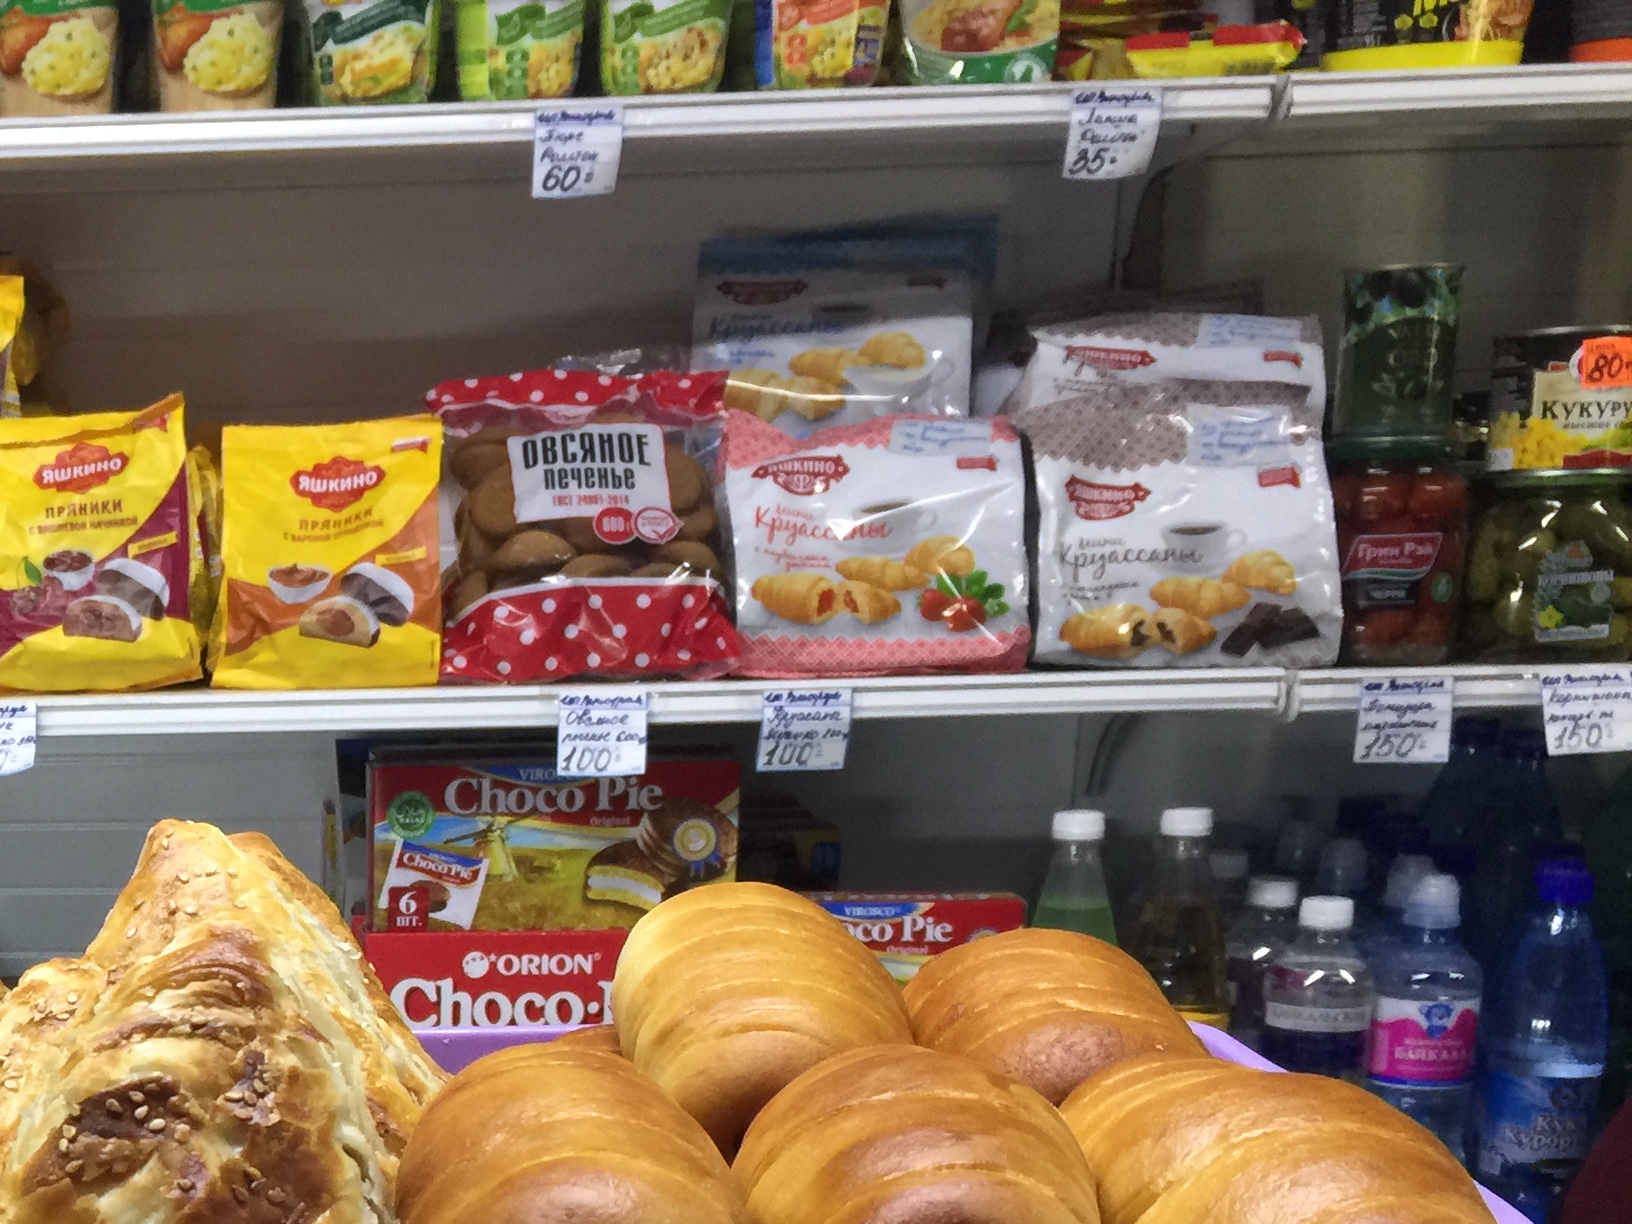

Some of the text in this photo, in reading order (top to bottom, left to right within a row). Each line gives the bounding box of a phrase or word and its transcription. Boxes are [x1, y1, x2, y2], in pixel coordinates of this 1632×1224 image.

[522, 432, 652, 470] ОВСЯНОЕ
[42, 456, 123, 484] ЯШКИНО
[298, 470, 378, 493] ЯШКИНО
[45, 499, 124, 519] ПРЯНИКИ
[299, 508, 373, 532] ПРЯНИКИ
[444, 776, 585, 815] Choco
[596, 775, 664, 812] Pie
[402, 851, 448, 874] Choco
[398, 890, 418, 915] 6
[900, 914, 954, 943] Pie
[496, 952, 595, 976] ORION
